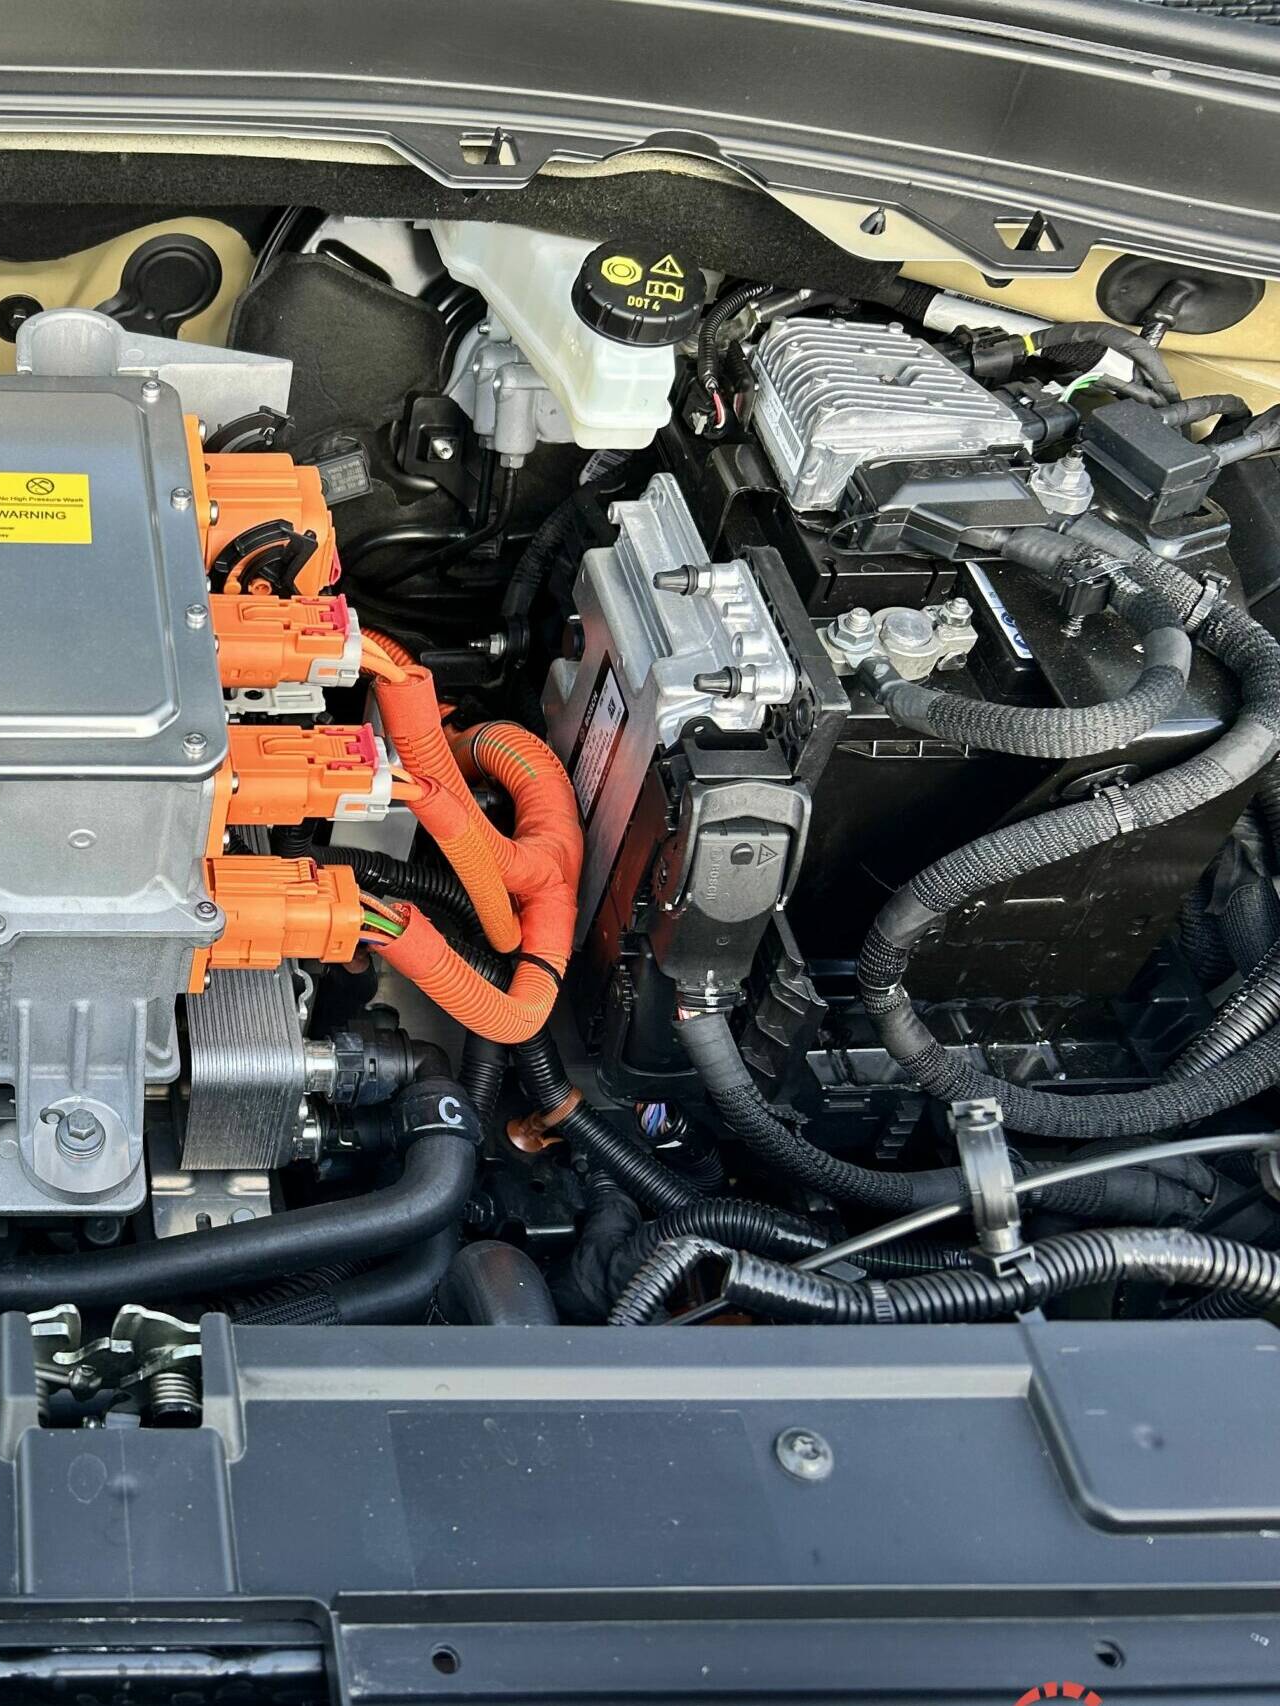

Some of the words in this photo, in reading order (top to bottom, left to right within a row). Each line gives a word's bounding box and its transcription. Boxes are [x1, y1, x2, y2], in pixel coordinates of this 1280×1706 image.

[627, 295, 651, 309] DOT
[652, 300, 661, 312] 4
[584, 690, 599, 728] BOSCH
[438, 1096, 463, 1125] C
